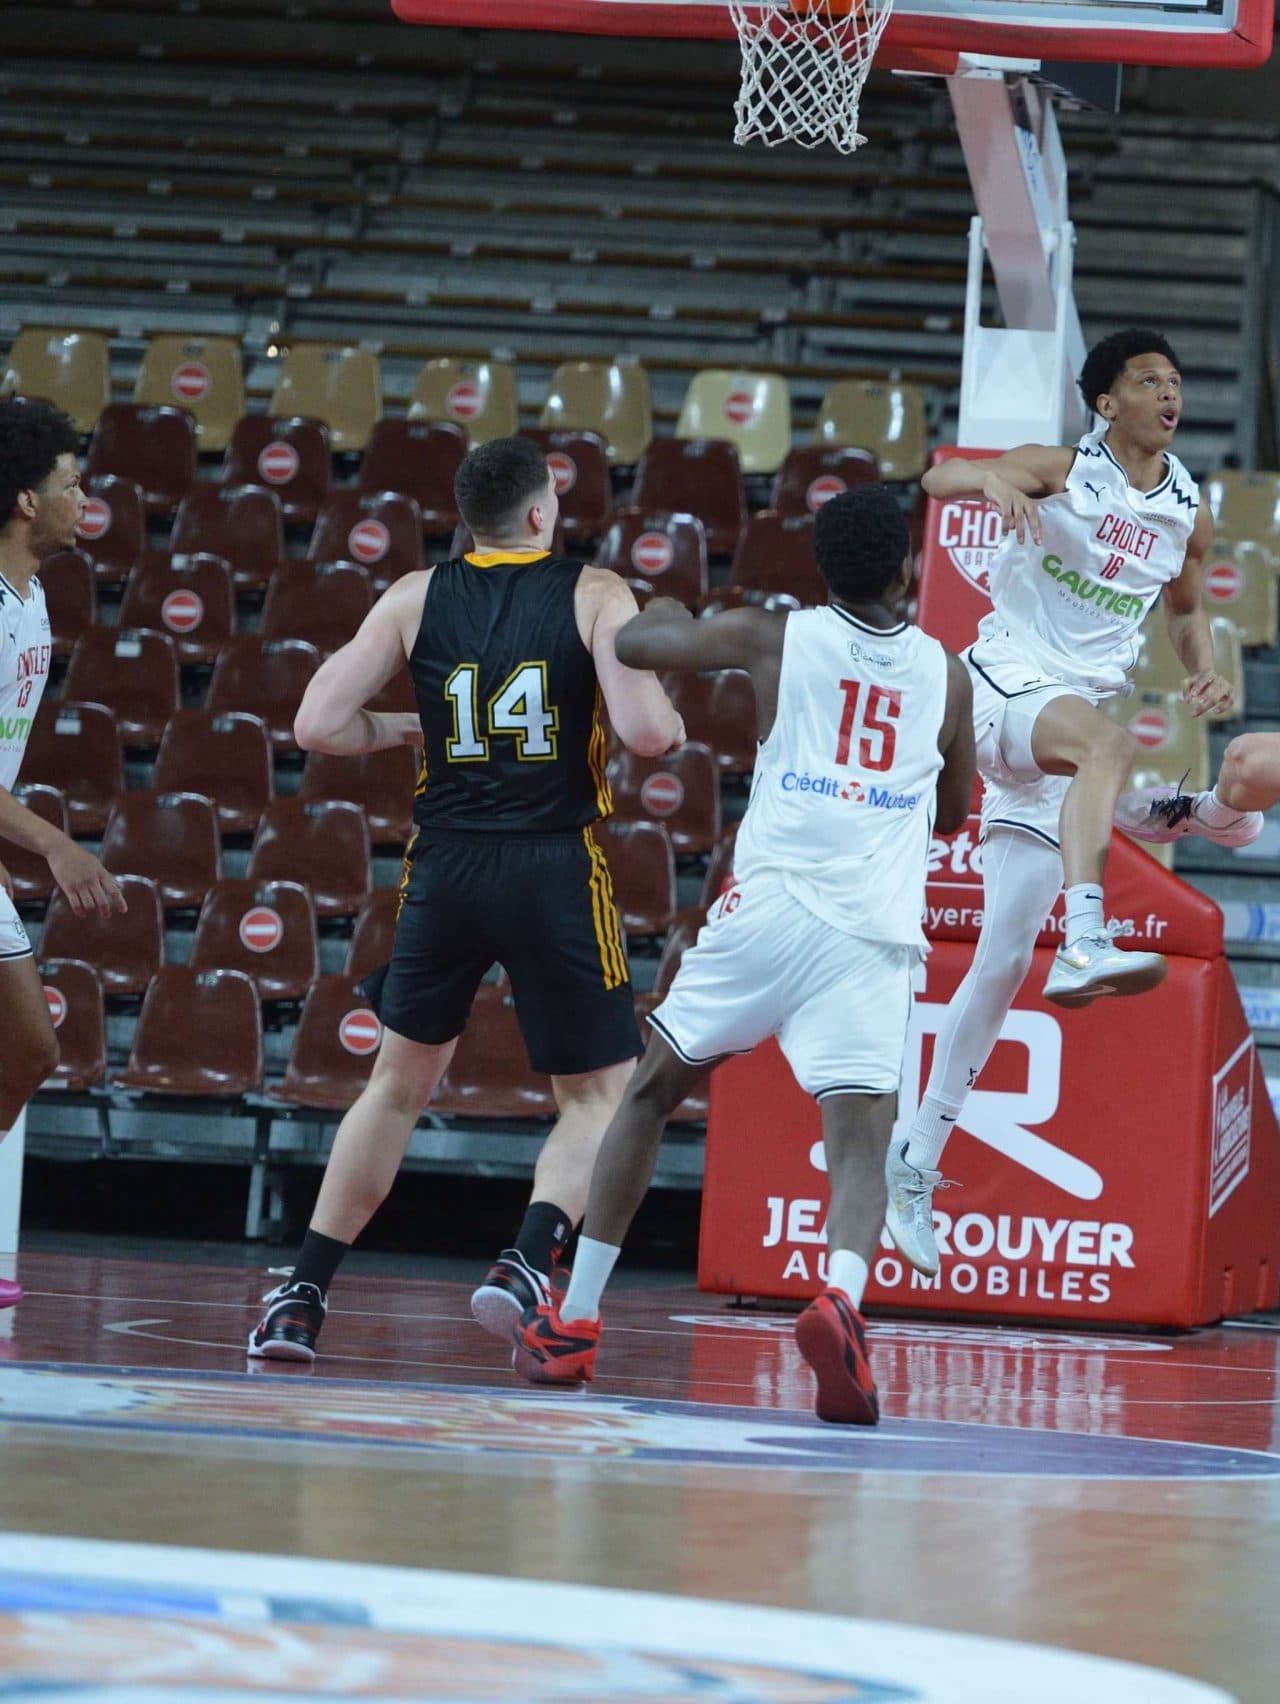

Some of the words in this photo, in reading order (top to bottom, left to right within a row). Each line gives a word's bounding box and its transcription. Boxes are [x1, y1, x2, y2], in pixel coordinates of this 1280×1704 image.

[939, 504, 1003, 547] CHO
[1095, 513, 1159, 560] CHOLET
[963, 551, 995, 566] BAS
[1099, 552, 1126, 580] 16
[1041, 554, 1144, 621] GAUTIER
[16, 681, 32, 708] 13
[445, 660, 559, 762] 14
[835, 678, 903, 773] 15
[781, 772, 839, 798] Crédit
[782, 1250, 1111, 1304] AUOMOBILES
